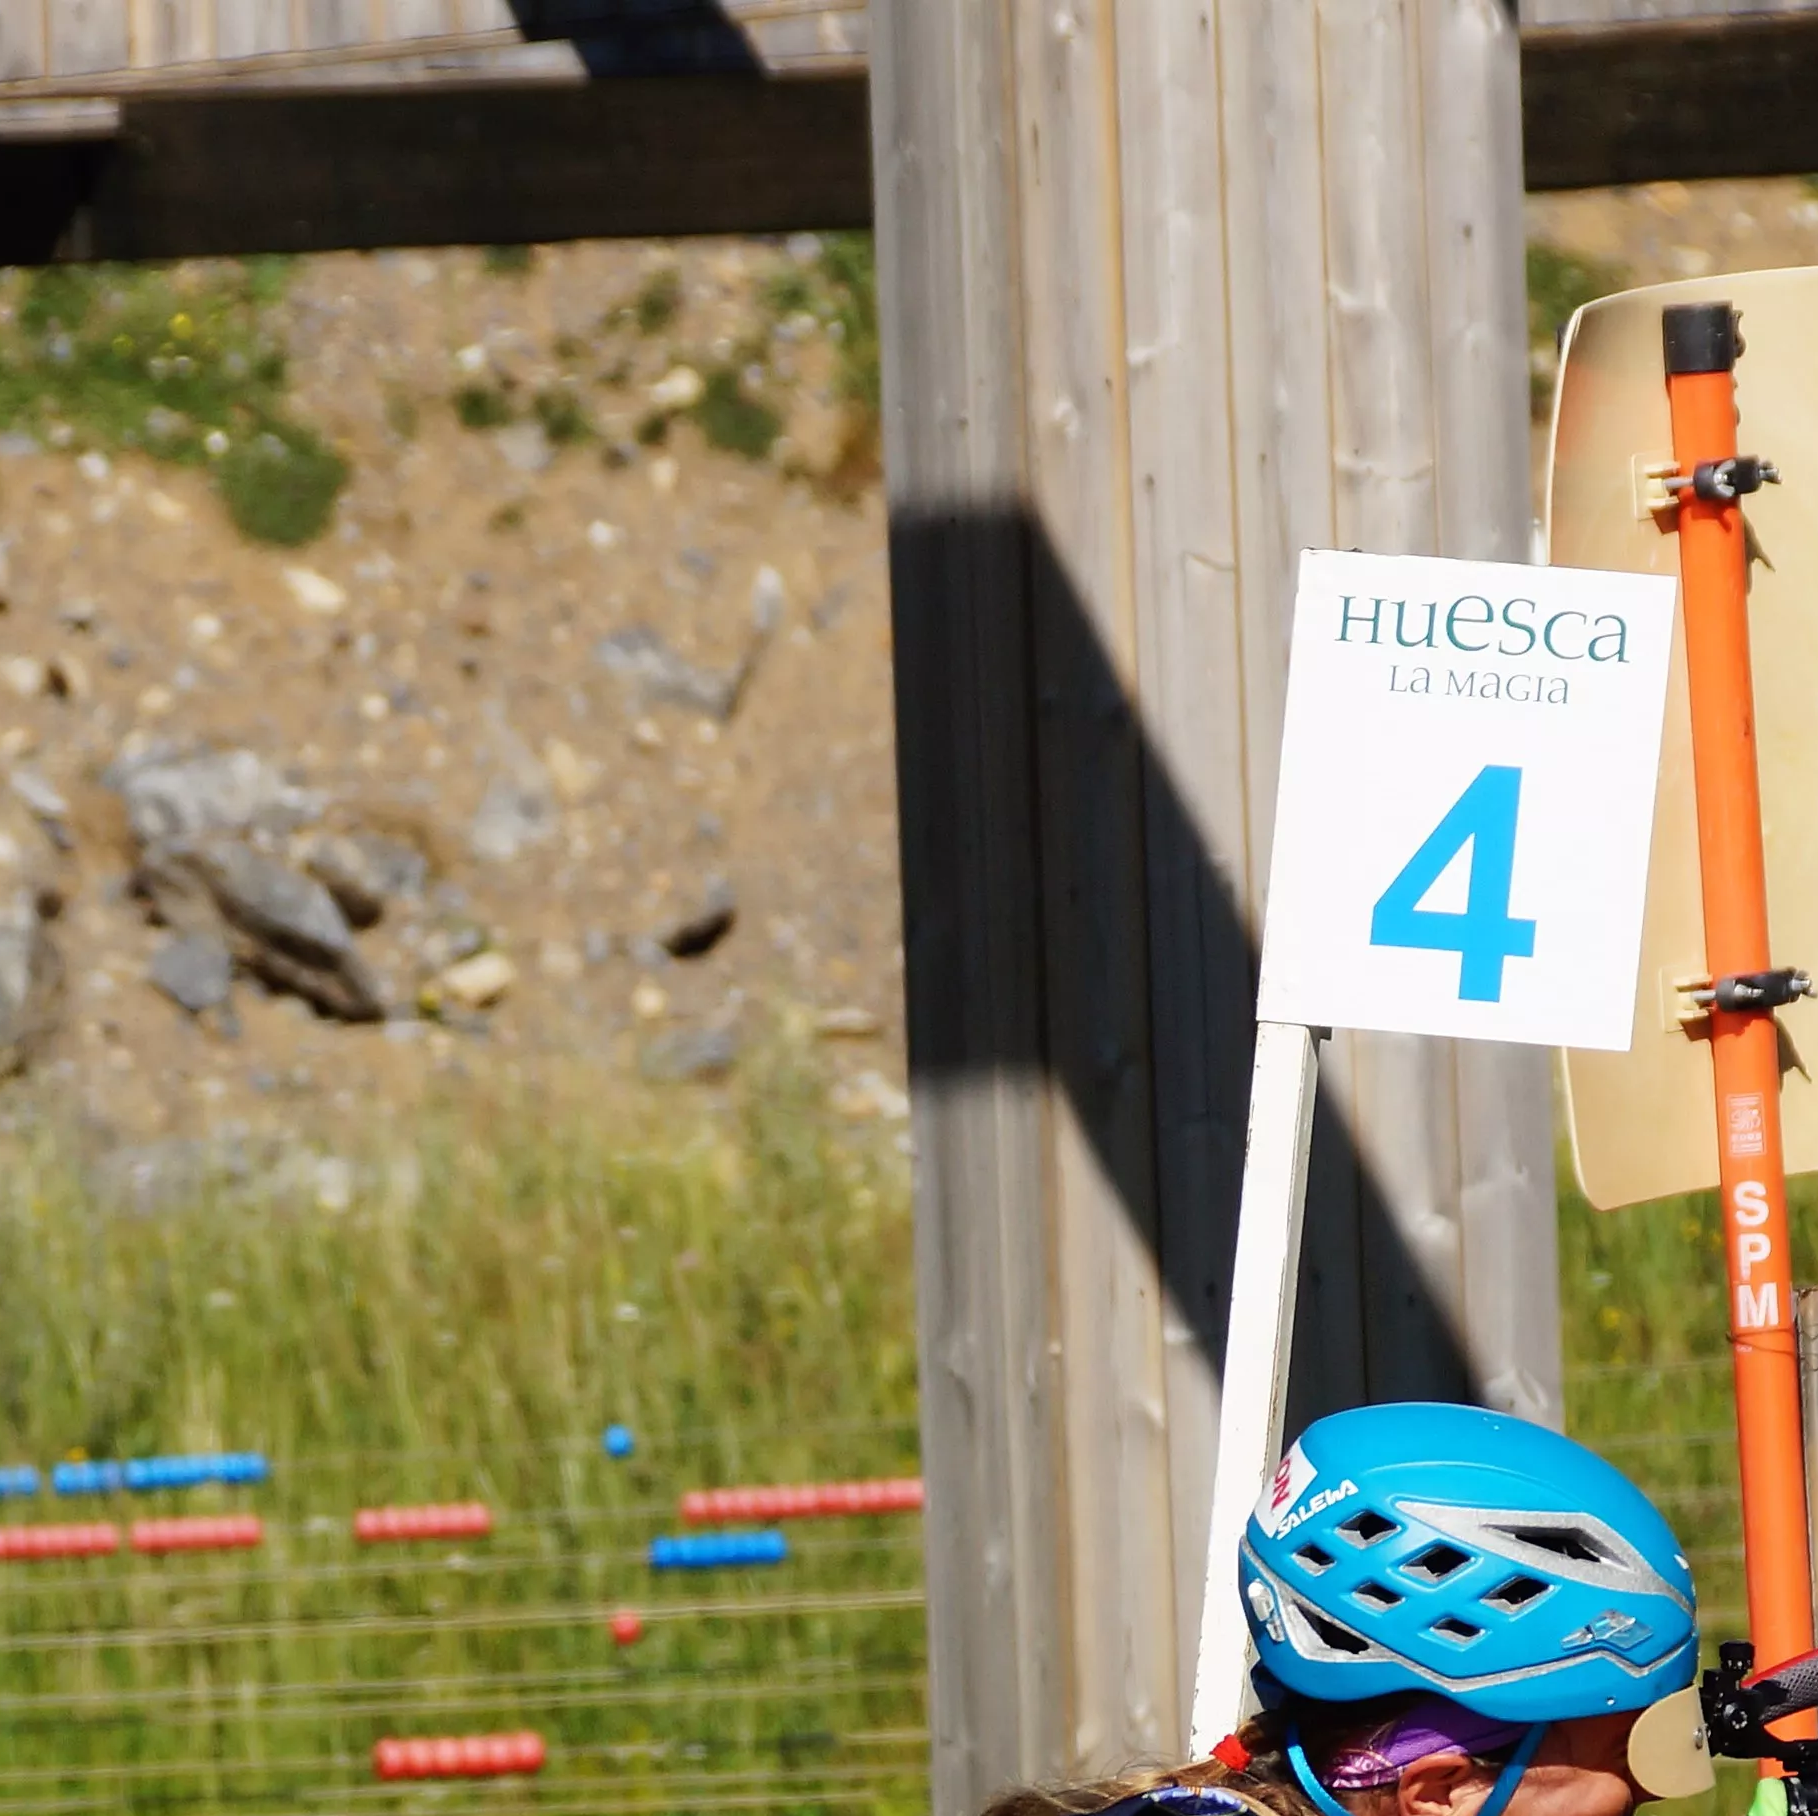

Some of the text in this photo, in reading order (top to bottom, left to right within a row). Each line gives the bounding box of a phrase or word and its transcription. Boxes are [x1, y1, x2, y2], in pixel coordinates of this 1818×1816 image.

[1335, 595, 1630, 663] Huesca
[1388, 664, 1431, 694] La
[1370, 764, 1537, 1003] 4
[1277, 1479, 1359, 1540] SALEWA
